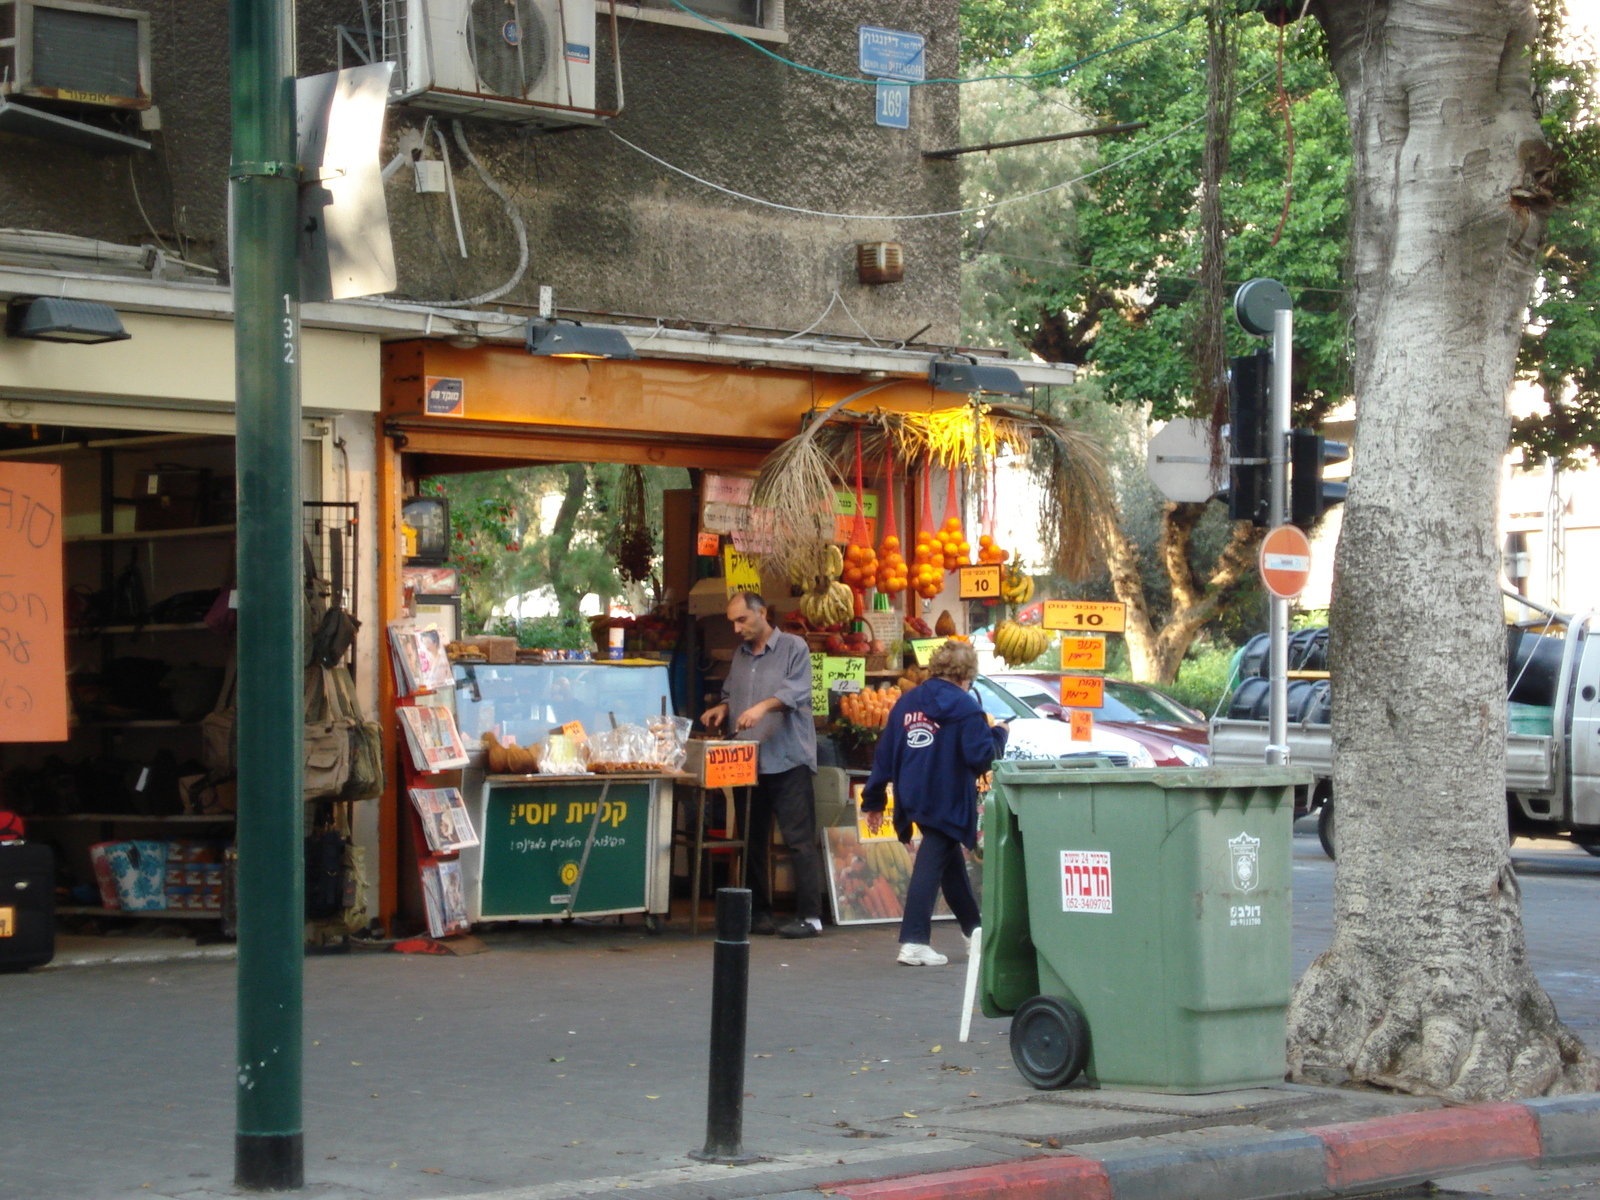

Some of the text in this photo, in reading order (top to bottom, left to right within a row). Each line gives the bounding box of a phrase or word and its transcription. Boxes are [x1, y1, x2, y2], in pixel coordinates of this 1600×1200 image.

[864, 31, 899, 47] דיזנגוף
[882, 89, 902, 118] 169
[974, 579, 989, 593] 10
[1073, 613, 1104, 626] 10
[708, 746, 754, 765] ערמונים
[518, 803, 558, 825] יוסי
[1081, 852, 1089, 864] 24
[1064, 865, 1111, 897] הדברה
[1066, 897, 1111, 910] 052-3409702
